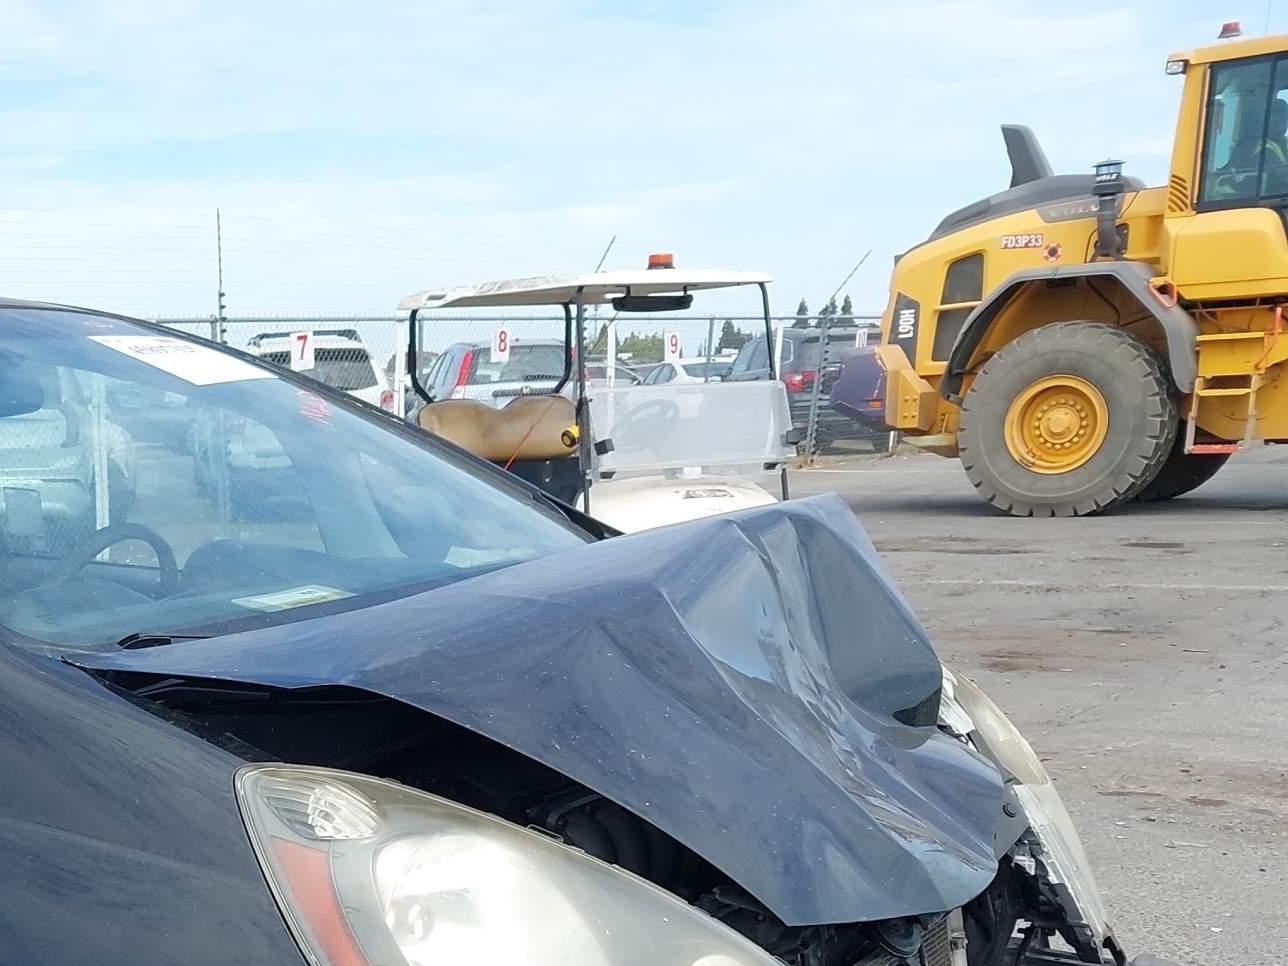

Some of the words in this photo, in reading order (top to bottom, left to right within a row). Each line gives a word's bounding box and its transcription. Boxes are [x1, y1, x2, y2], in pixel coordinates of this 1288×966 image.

[1049, 202, 1102, 217] VOLV
[1001, 234, 1043, 248] FD3P33
[897, 308, 916, 339] L90H
[297, 334, 309, 361] 7
[498, 330, 508, 353] 8
[670, 334, 678, 354] 9
